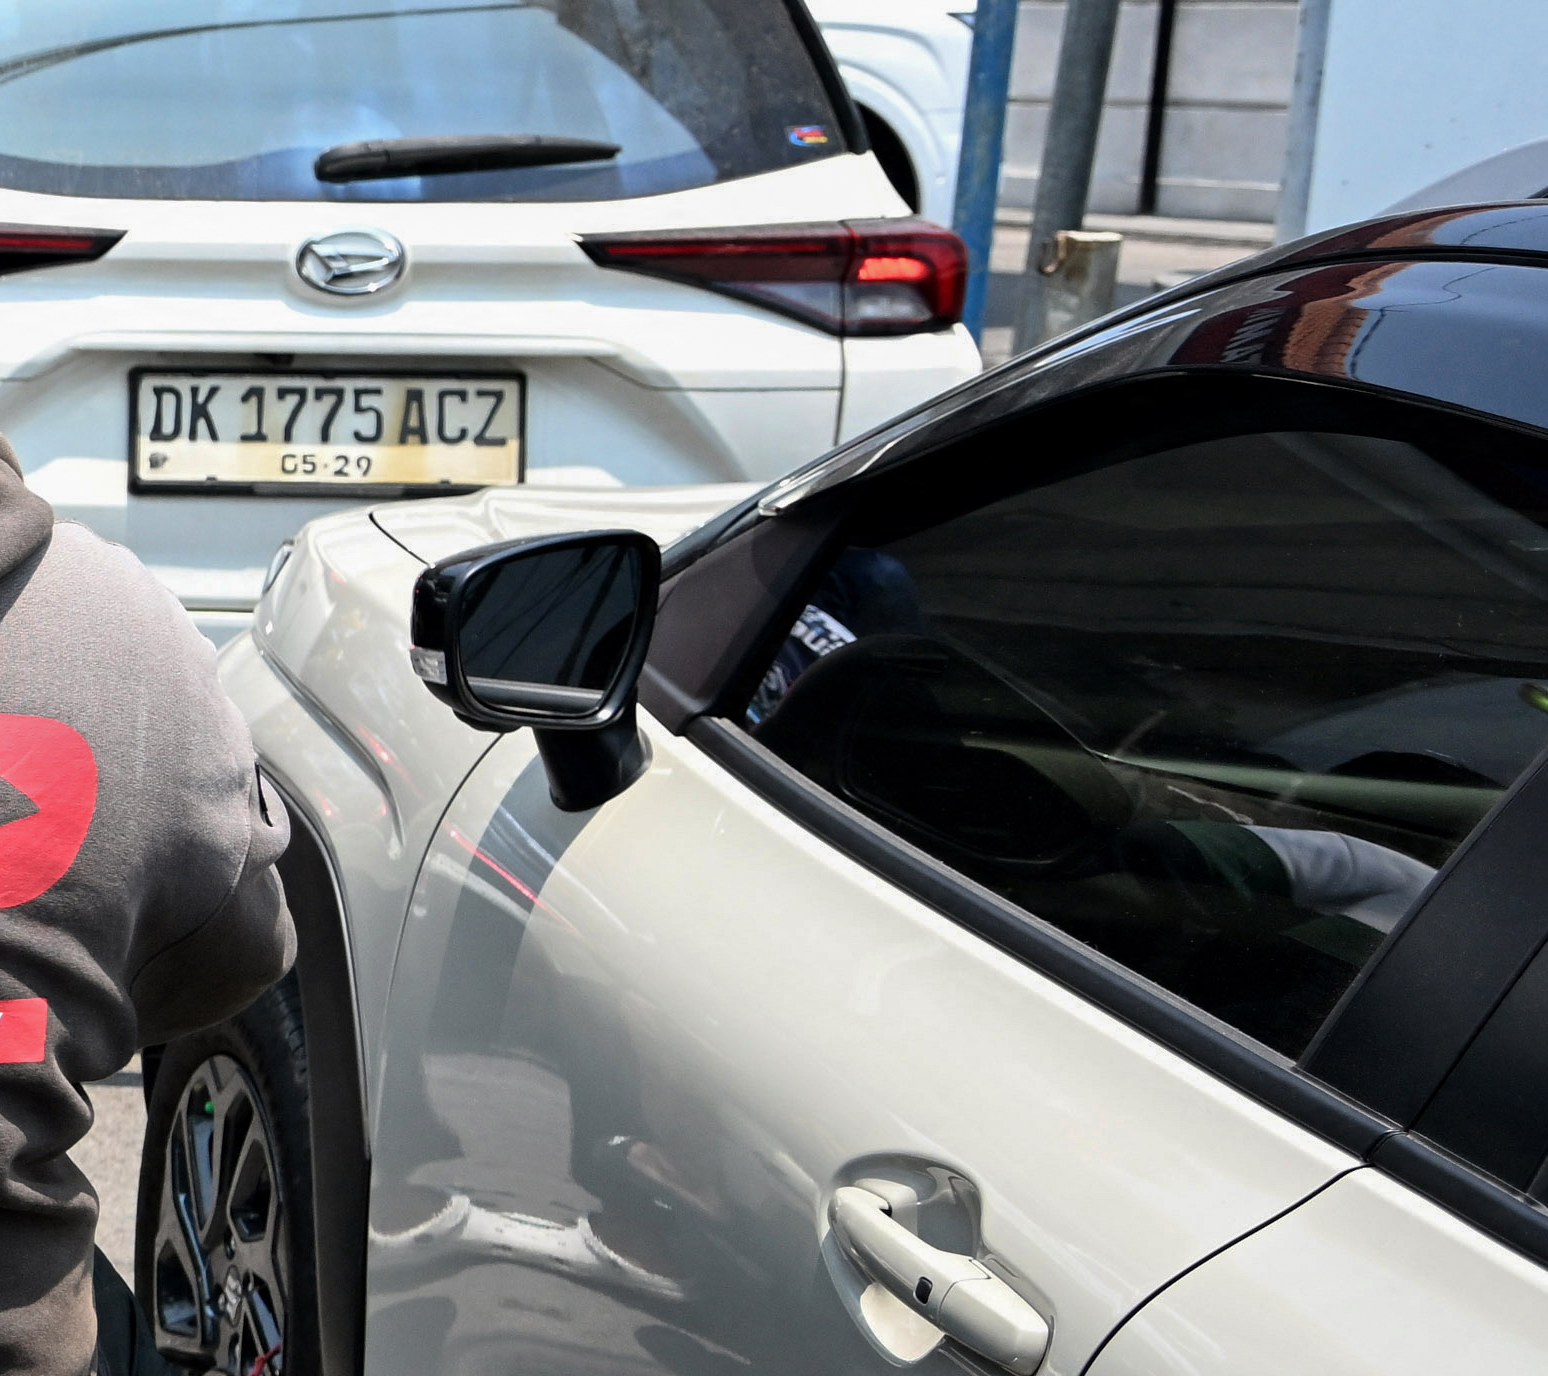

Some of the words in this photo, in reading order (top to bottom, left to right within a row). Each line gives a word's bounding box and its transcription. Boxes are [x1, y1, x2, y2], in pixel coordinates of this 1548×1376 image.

[148, 385, 222, 443] DK
[238, 387, 385, 444] 1775
[398, 388, 510, 447] ACZ
